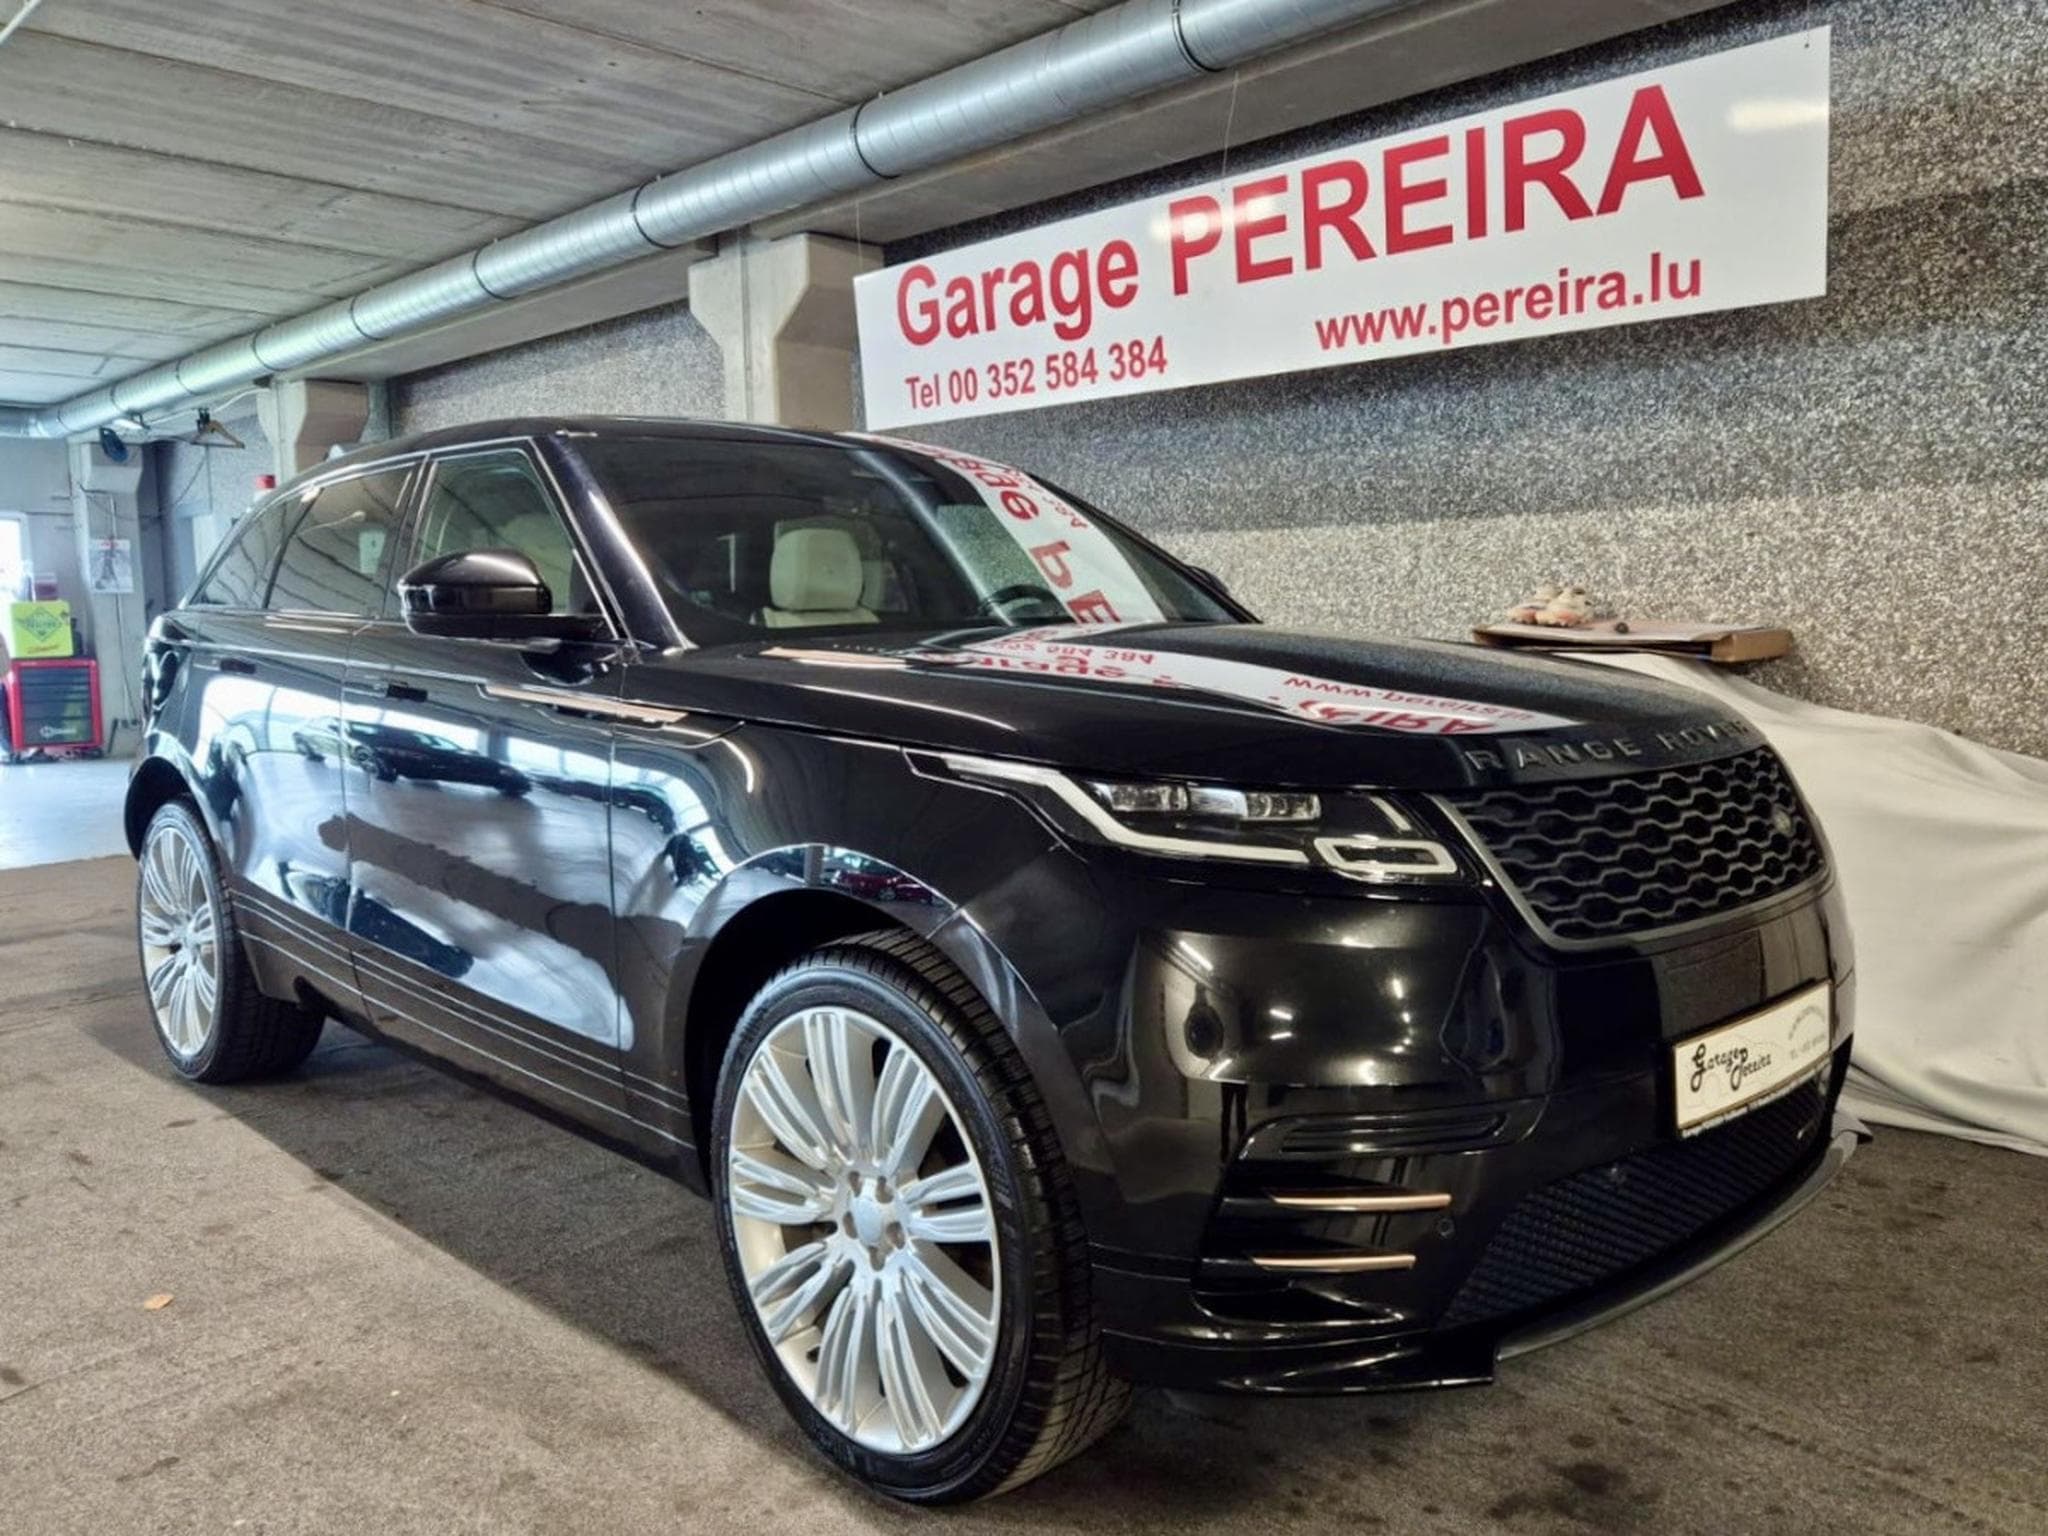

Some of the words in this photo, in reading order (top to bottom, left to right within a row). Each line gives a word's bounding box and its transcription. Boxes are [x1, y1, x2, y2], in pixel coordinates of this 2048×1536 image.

[896, 239, 1139, 346] Garage
[1169, 84, 1705, 296] PEREIRA
[1316, 252, 1702, 350] www.pereira.lu
[905, 373, 941, 409] Tel
[949, 367, 978, 404] 00
[986, 358, 1036, 399] 352
[1045, 346, 1099, 390] 584
[1108, 335, 1168, 382] 384
[1464, 737, 1642, 771] RANGE
[1656, 720, 1750, 751] ROVER
